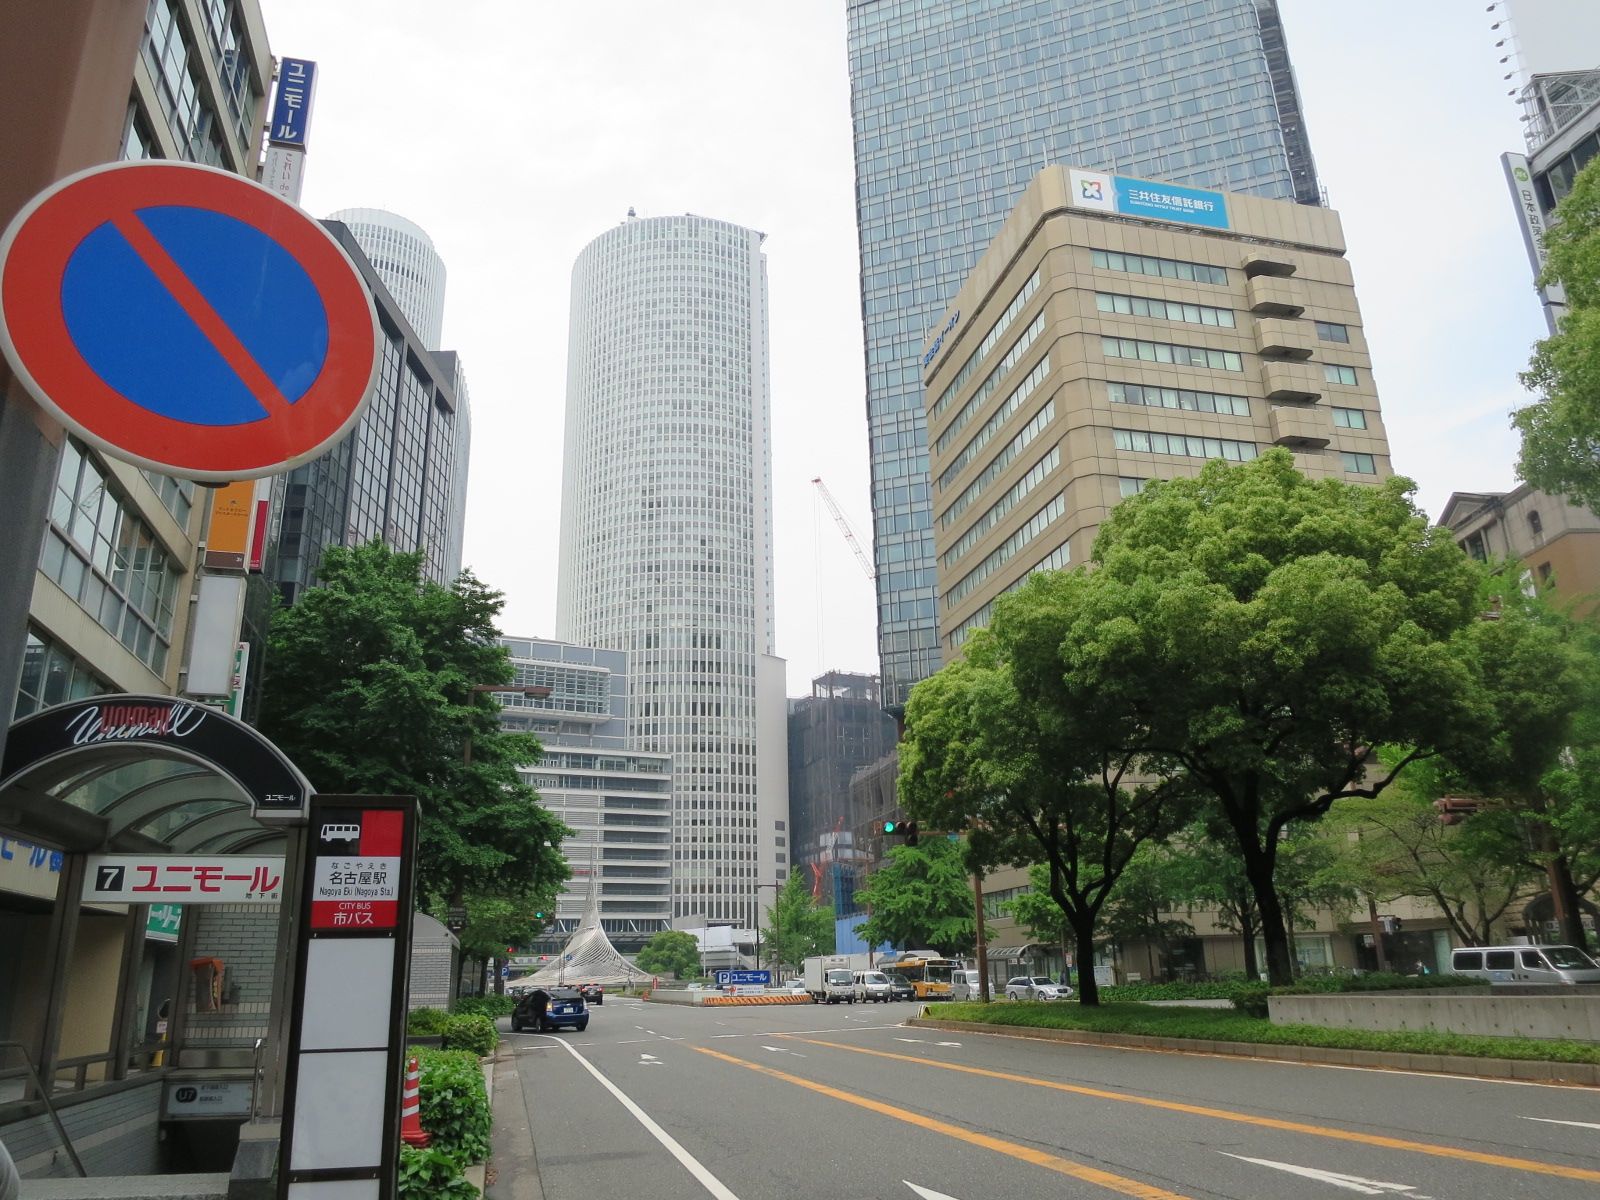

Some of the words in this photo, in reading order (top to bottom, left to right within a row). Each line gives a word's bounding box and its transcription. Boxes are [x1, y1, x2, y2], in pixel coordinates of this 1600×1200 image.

[278, 62, 306, 139] ユニモール
[1128, 189, 1214, 212] 三井住友信託銀行
[102, 868, 119, 889] 7
[132, 865, 280, 892] ユニモール
[329, 871, 387, 885] 名古屋駅
[320, 887, 341, 897] Nagoya
[343, 887, 353, 896] Eki
[354, 887, 378, 898] (Nagoya
[338, 902, 356, 910] CITY
[357, 902, 371, 910] BUS
[334, 912, 374, 925] 市バス
[502, 968, 508, 976] P
[732, 973, 767, 982] ユニモール
